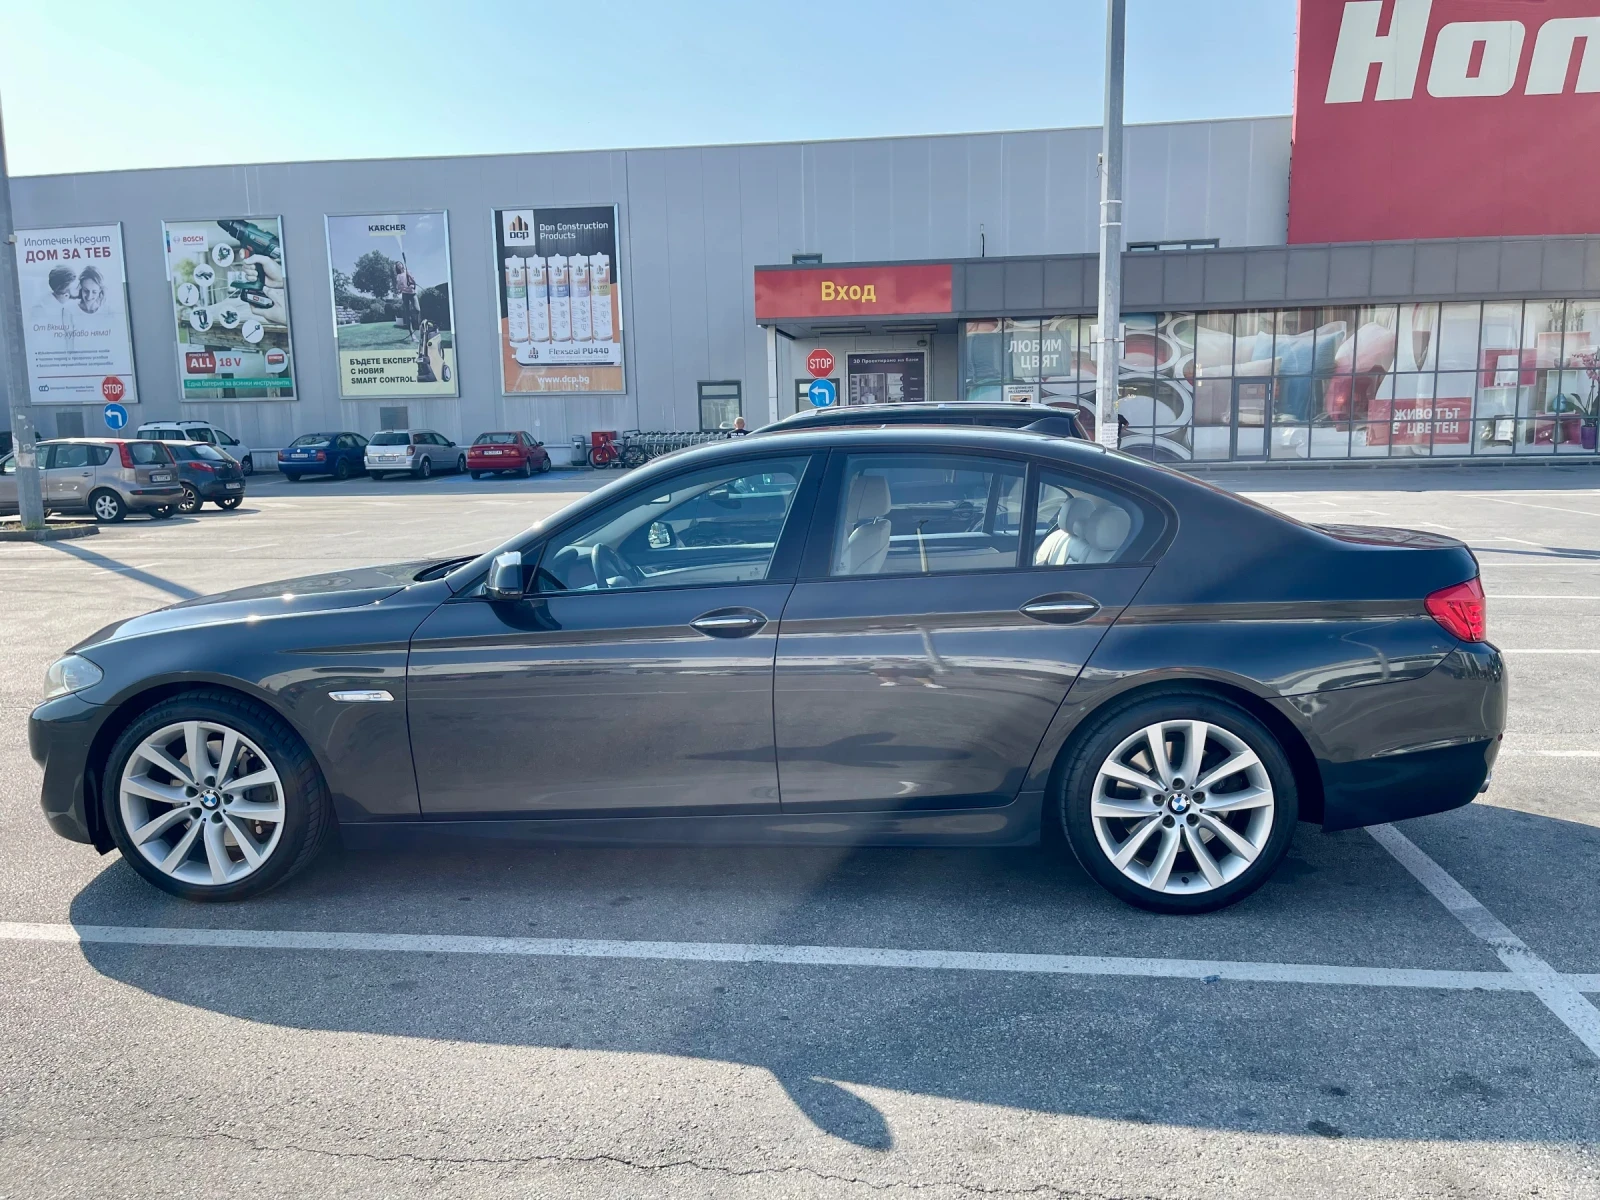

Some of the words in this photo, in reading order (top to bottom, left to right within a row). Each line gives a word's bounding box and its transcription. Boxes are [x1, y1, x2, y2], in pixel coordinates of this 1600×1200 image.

[557, 221, 609, 231] Construction
[24, 237, 72, 247] Ипотечен
[73, 234, 111, 246] кредит
[540, 232, 576, 240] Products
[25, 249, 58, 264] ДОМ
[62, 248, 81, 260] ЗА
[84, 246, 112, 259] ТЕБ
[821, 281, 877, 303] Вход
[33, 324, 46, 332] От
[582, 347, 610, 355] PU440
[1008, 339, 1062, 353] ЛЮБИМ
[190, 358, 213, 368] ALL
[219, 358, 233, 367] 18
[233, 357, 242, 367] V
[349, 358, 381, 366] БЪДЕТЕ
[809, 357, 832, 370] STOP
[1020, 354, 1059, 370] ЦВЯТ
[357, 367, 385, 375] НОВИЯ
[538, 374, 590, 385] www.dcp.bg
[103, 384, 123, 394] STOP
[1394, 407, 1461, 420] ЖИВОТЪТ
[1392, 421, 1400, 435] Е
[1406, 421, 1459, 436] ЦВЕТЕН
